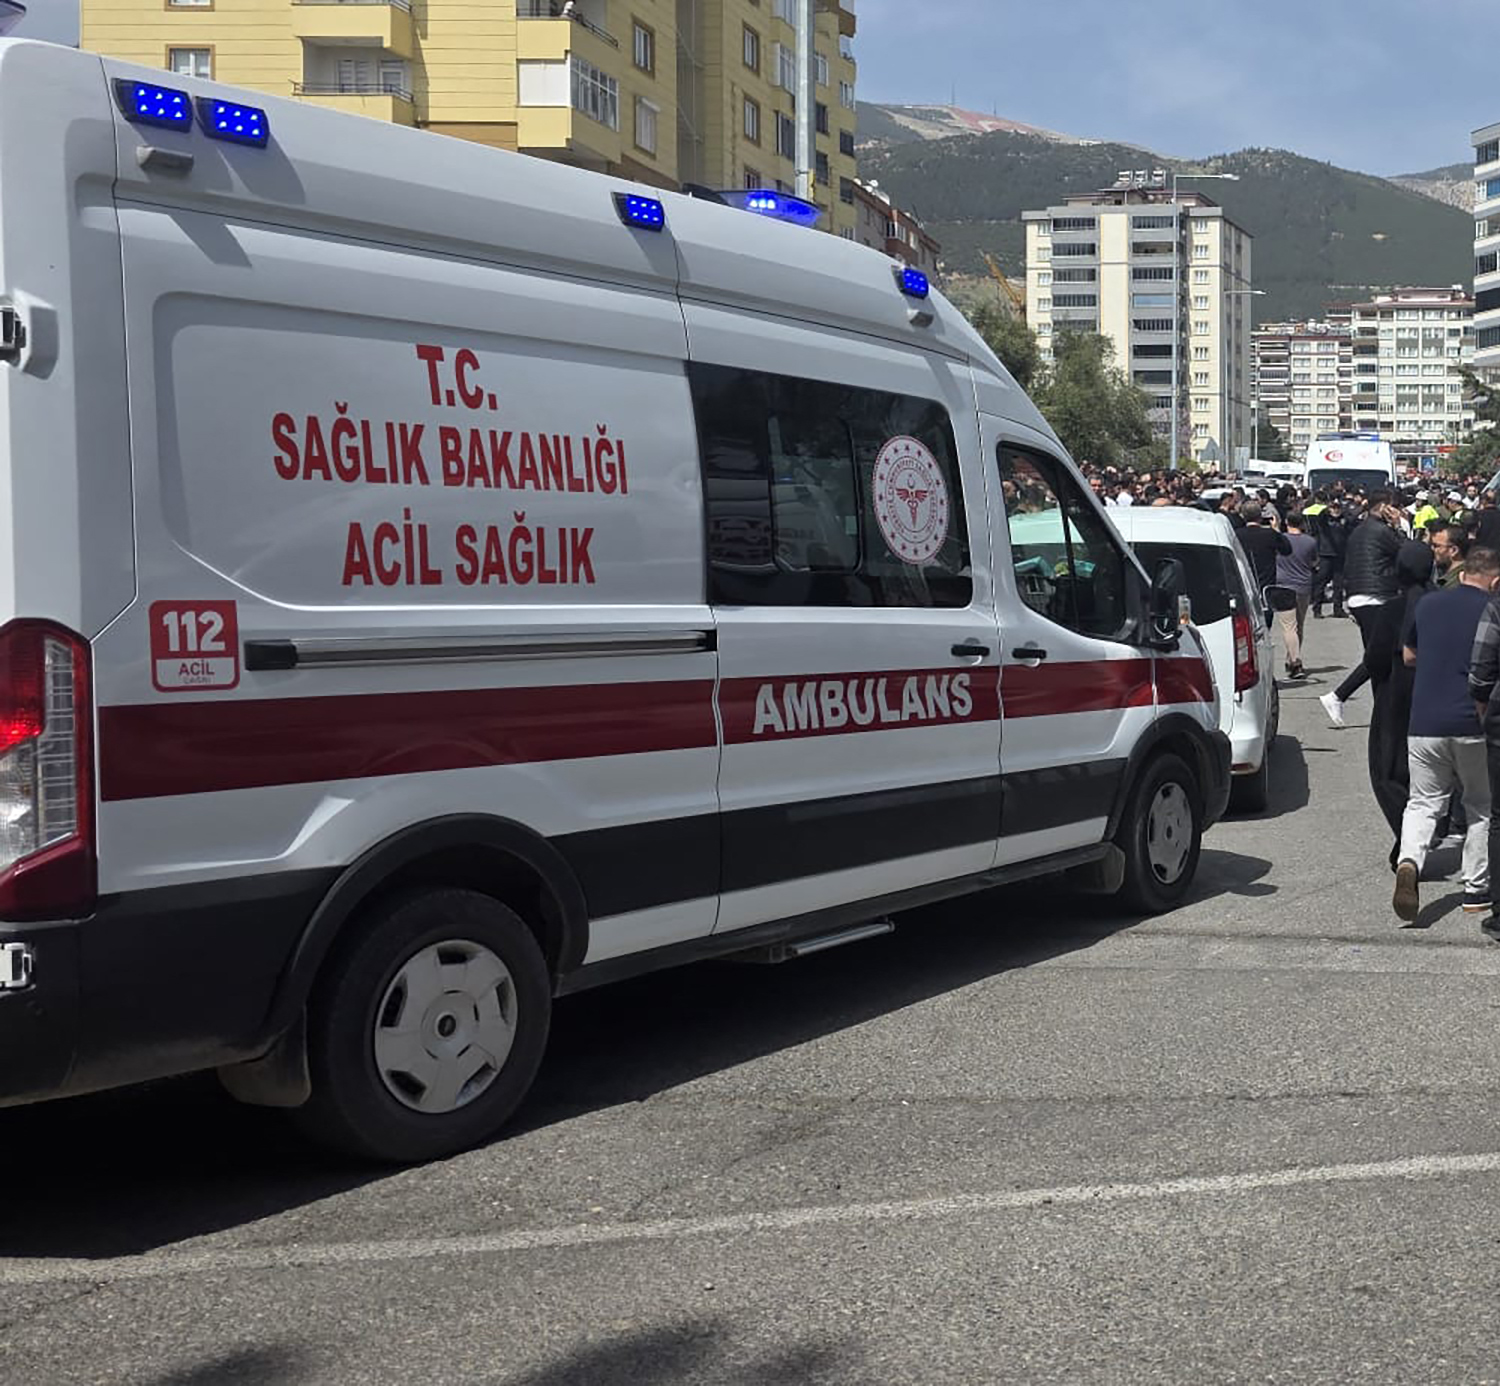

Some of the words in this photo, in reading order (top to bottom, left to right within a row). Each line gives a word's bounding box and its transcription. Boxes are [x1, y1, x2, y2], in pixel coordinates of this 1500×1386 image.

[416, 344, 498, 410] T.C.
[272, 401, 430, 485] SAĞLIK
[439, 424, 628, 494] BAKANLIĞI
[342, 508, 443, 587] ACİL
[456, 511, 596, 587] SAĞLIK
[162, 611, 226, 652] 112
[178, 659, 215, 676] ACİL
[752, 673, 973, 735] AMBULANS
